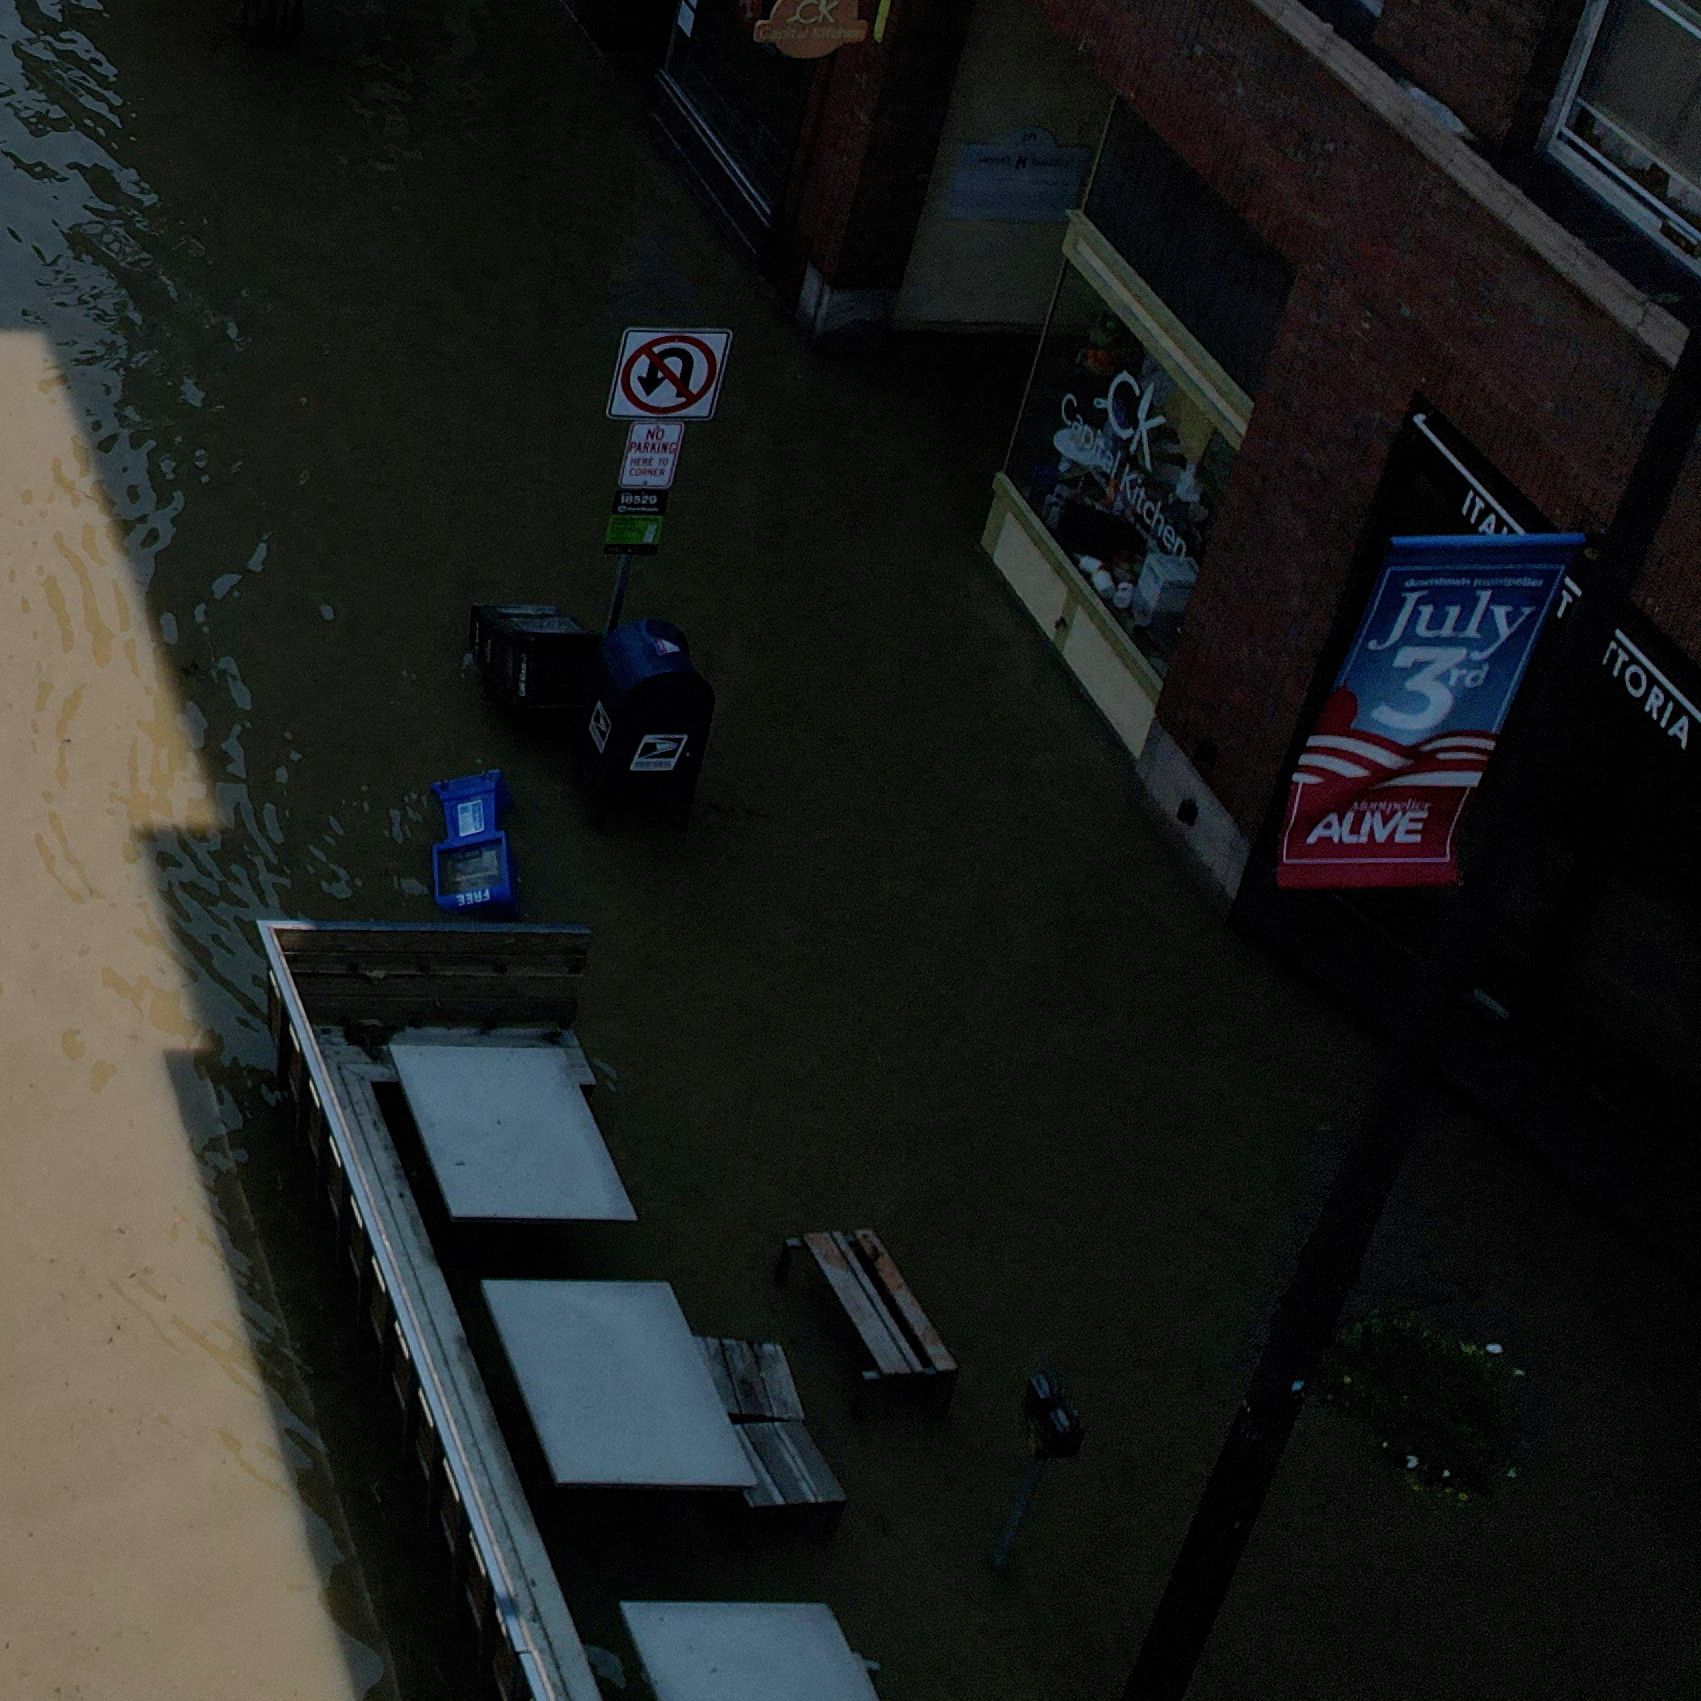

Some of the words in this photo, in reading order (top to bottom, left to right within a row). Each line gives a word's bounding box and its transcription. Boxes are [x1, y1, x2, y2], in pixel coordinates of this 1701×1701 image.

[645, 428, 666, 441] NO
[629, 442, 678, 454] PARKING
[630, 457, 654, 466] HERE
[657, 457, 669, 467] TO
[628, 467, 665, 477] CORNER
[1060, 392, 1122, 480] Capital
[1119, 462, 1188, 561] Kitchen
[1368, 588, 1537, 660] July
[1305, 810, 1431, 845] ALIVE
[456, 887, 492, 907] FREE
